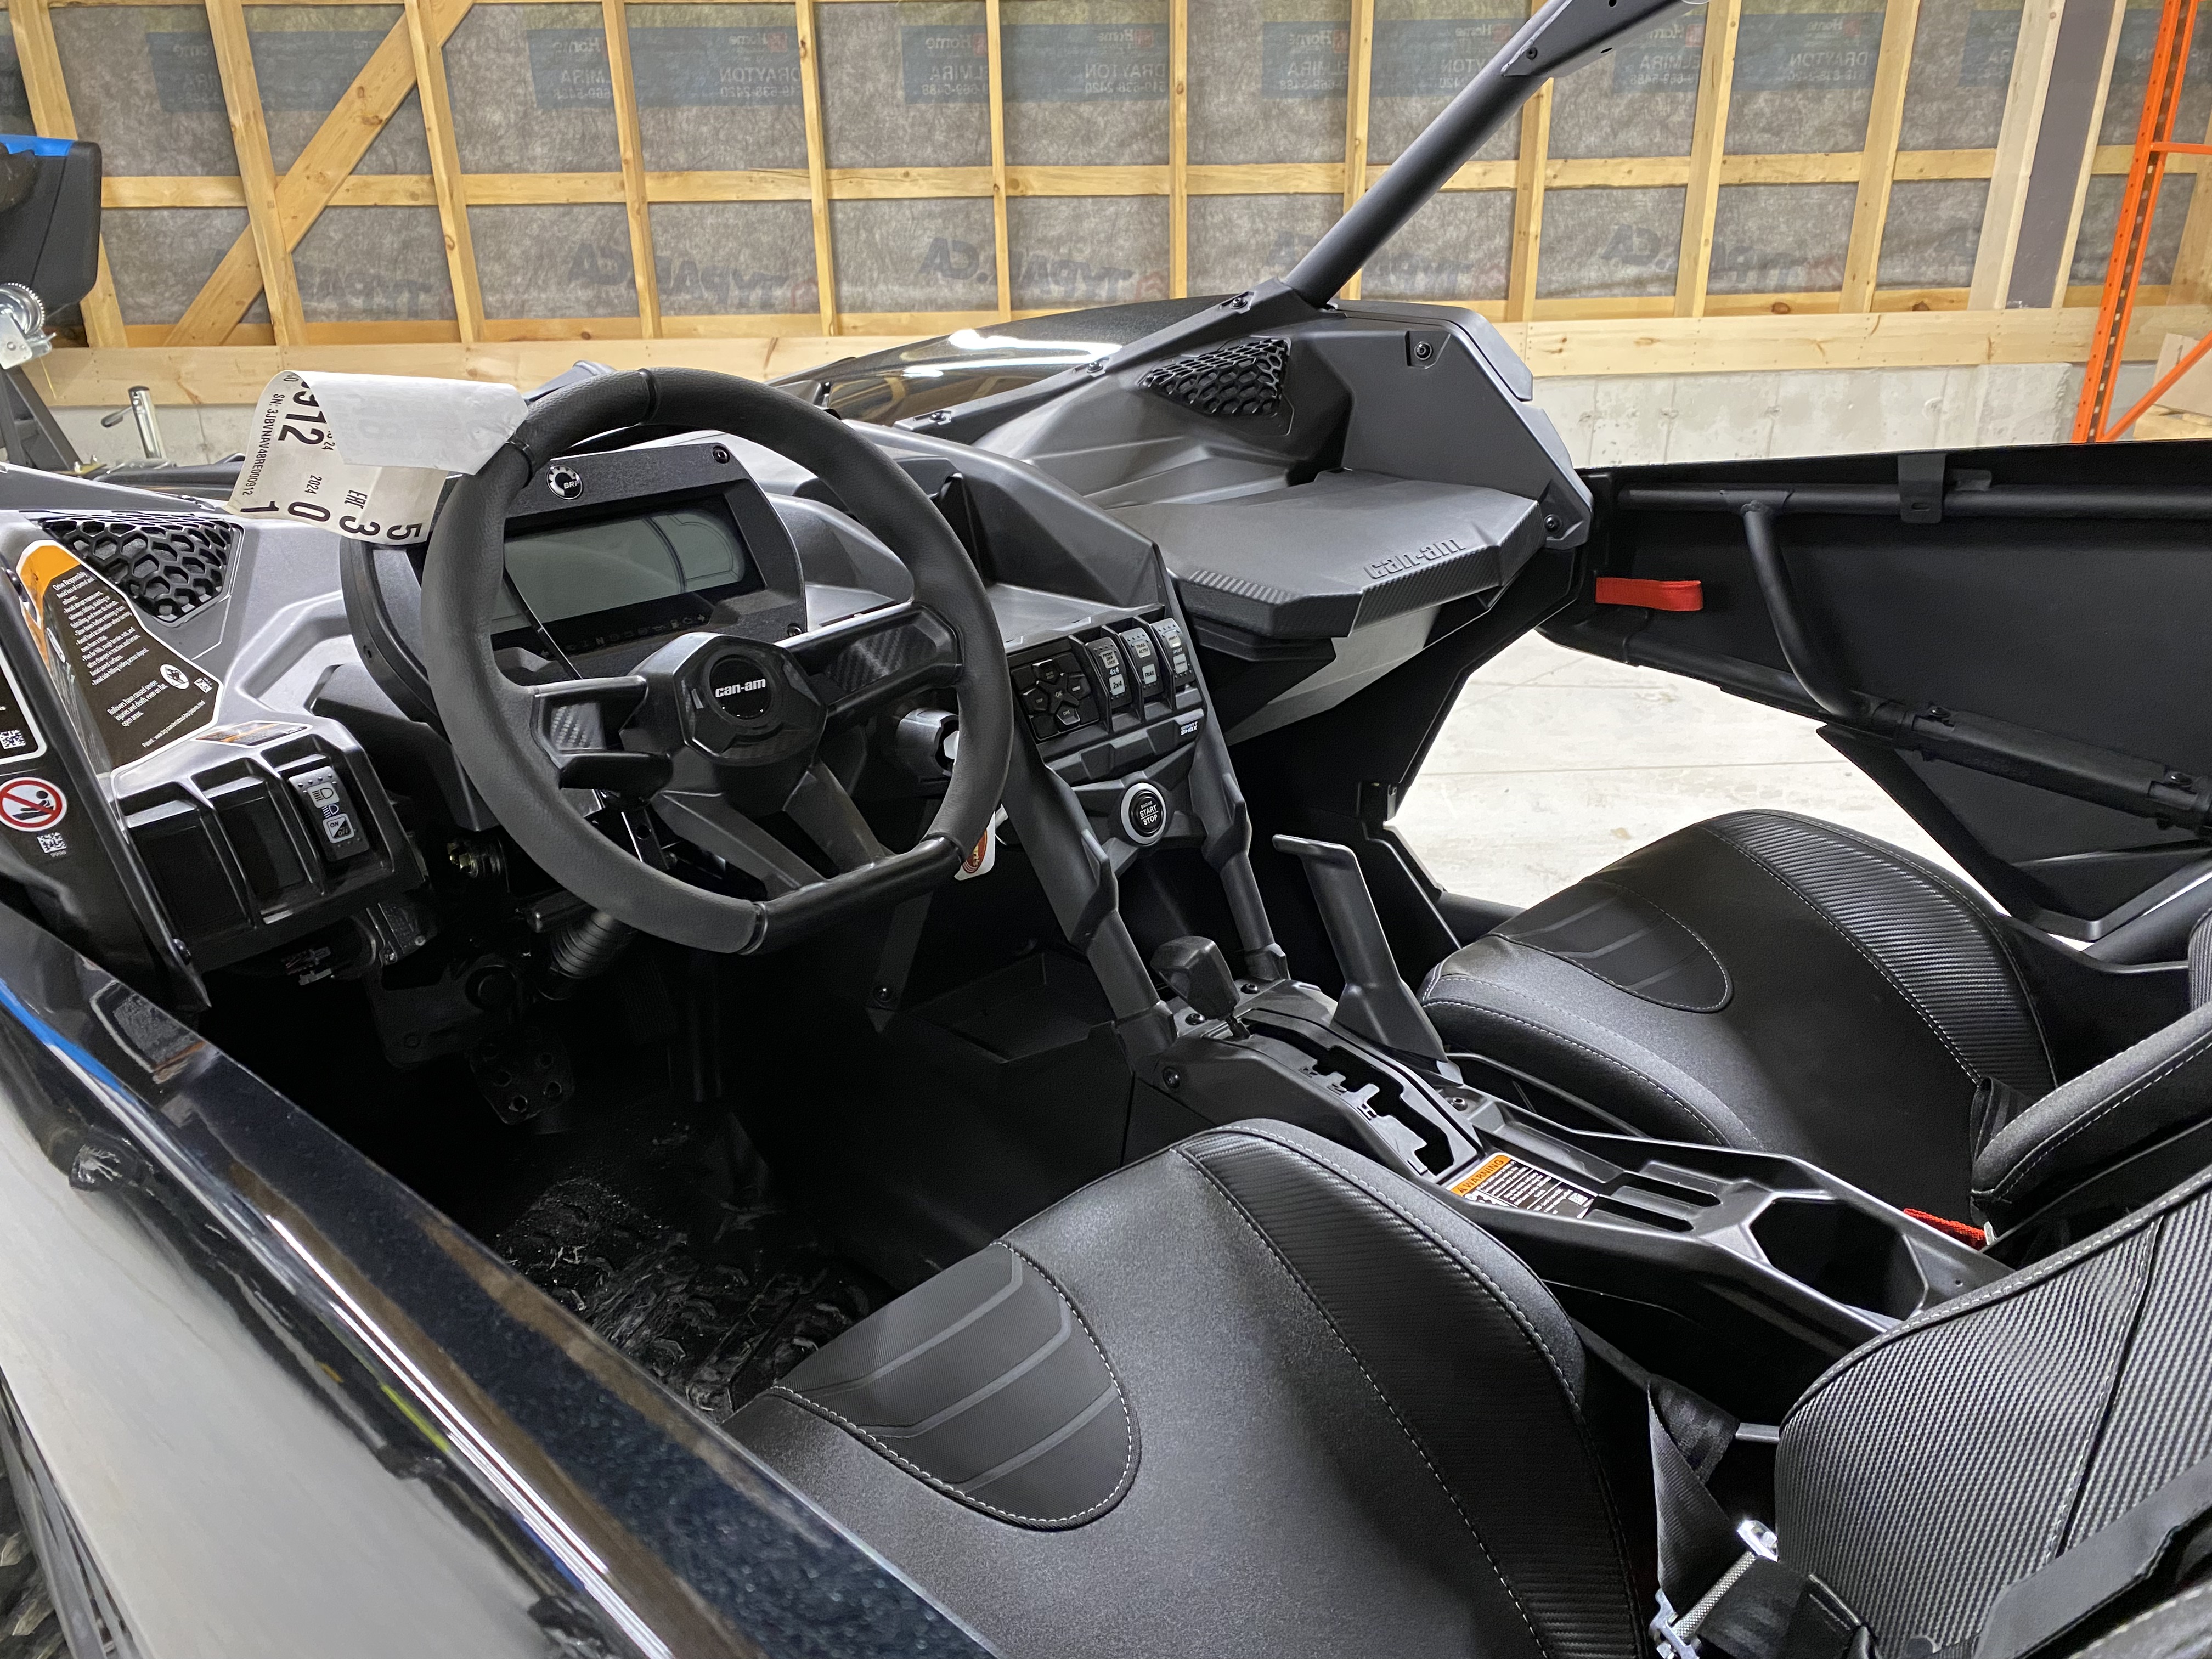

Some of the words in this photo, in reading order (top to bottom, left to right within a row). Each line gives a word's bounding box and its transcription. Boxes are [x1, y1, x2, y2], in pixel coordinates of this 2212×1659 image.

[269, 394, 285, 407] SN:
[304, 475, 323, 495] 2024
[563, 480, 580, 489] BRP
[240, 501, 280, 514] 1
[287, 501, 331, 522] 0
[338, 515, 381, 537] 3
[386, 523, 422, 540] 5
[1363, 539, 1466, 579] can-am
[52, 583, 66, 591] Drive
[1109, 667, 1119, 676] 4x4
[715, 678, 766, 698] can-am
[1113, 680, 1122, 690] 2x4
[107, 702, 127, 715] Rollovers
[122, 696, 136, 704] have
[133, 686, 147, 698] caused
[144, 680, 158, 690] severe
[1054, 690, 1063, 698] OK
[114, 709, 131, 721] injuries
[128, 703, 137, 712] and
[146, 691, 156, 699] even
[121, 718, 133, 726] open
[1139, 804, 1156, 817] START
[1143, 814, 1158, 826] STOP
[337, 828, 349, 837] OFF
[1356, 1102, 1378, 1121] H
[1462, 1159, 1505, 1188] WARNING
